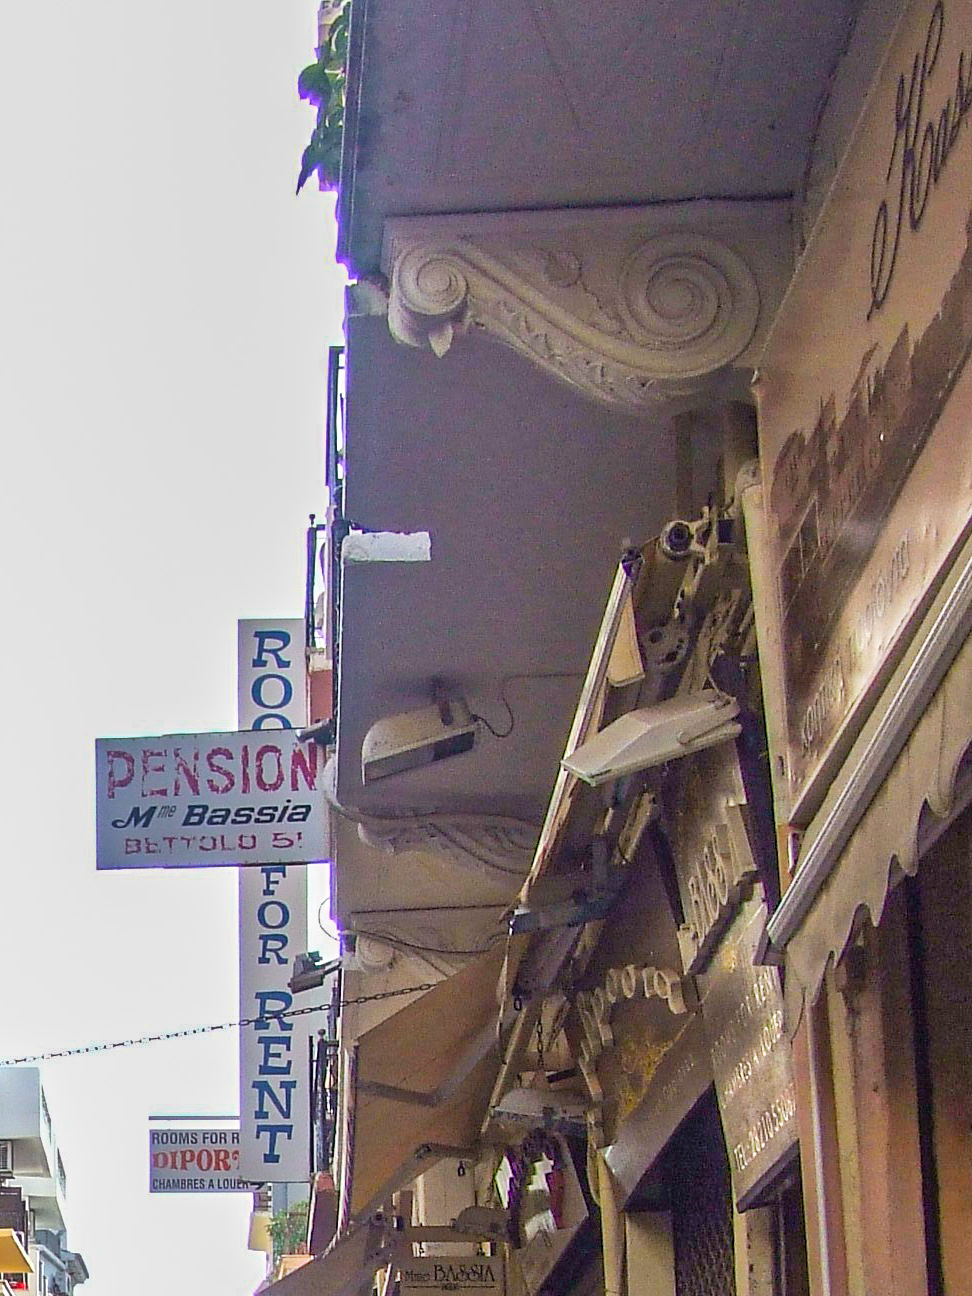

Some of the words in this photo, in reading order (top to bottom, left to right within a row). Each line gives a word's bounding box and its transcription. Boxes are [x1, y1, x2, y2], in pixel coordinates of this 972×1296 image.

[106, 743, 318, 799] PENSION
[111, 805, 177, 829] Mme
[181, 799, 312, 827] Bassia
[257, 866, 290, 965] FOR
[252, 990, 297, 1164] RENT
[152, 1132, 198, 1145] ROOMS
[202, 1132, 227, 1145] FOR
[153, 1179, 205, 1190] CHAMBRES
[208, 1179, 215, 1190] A
[434, 1264, 495, 1283] BASSIA
